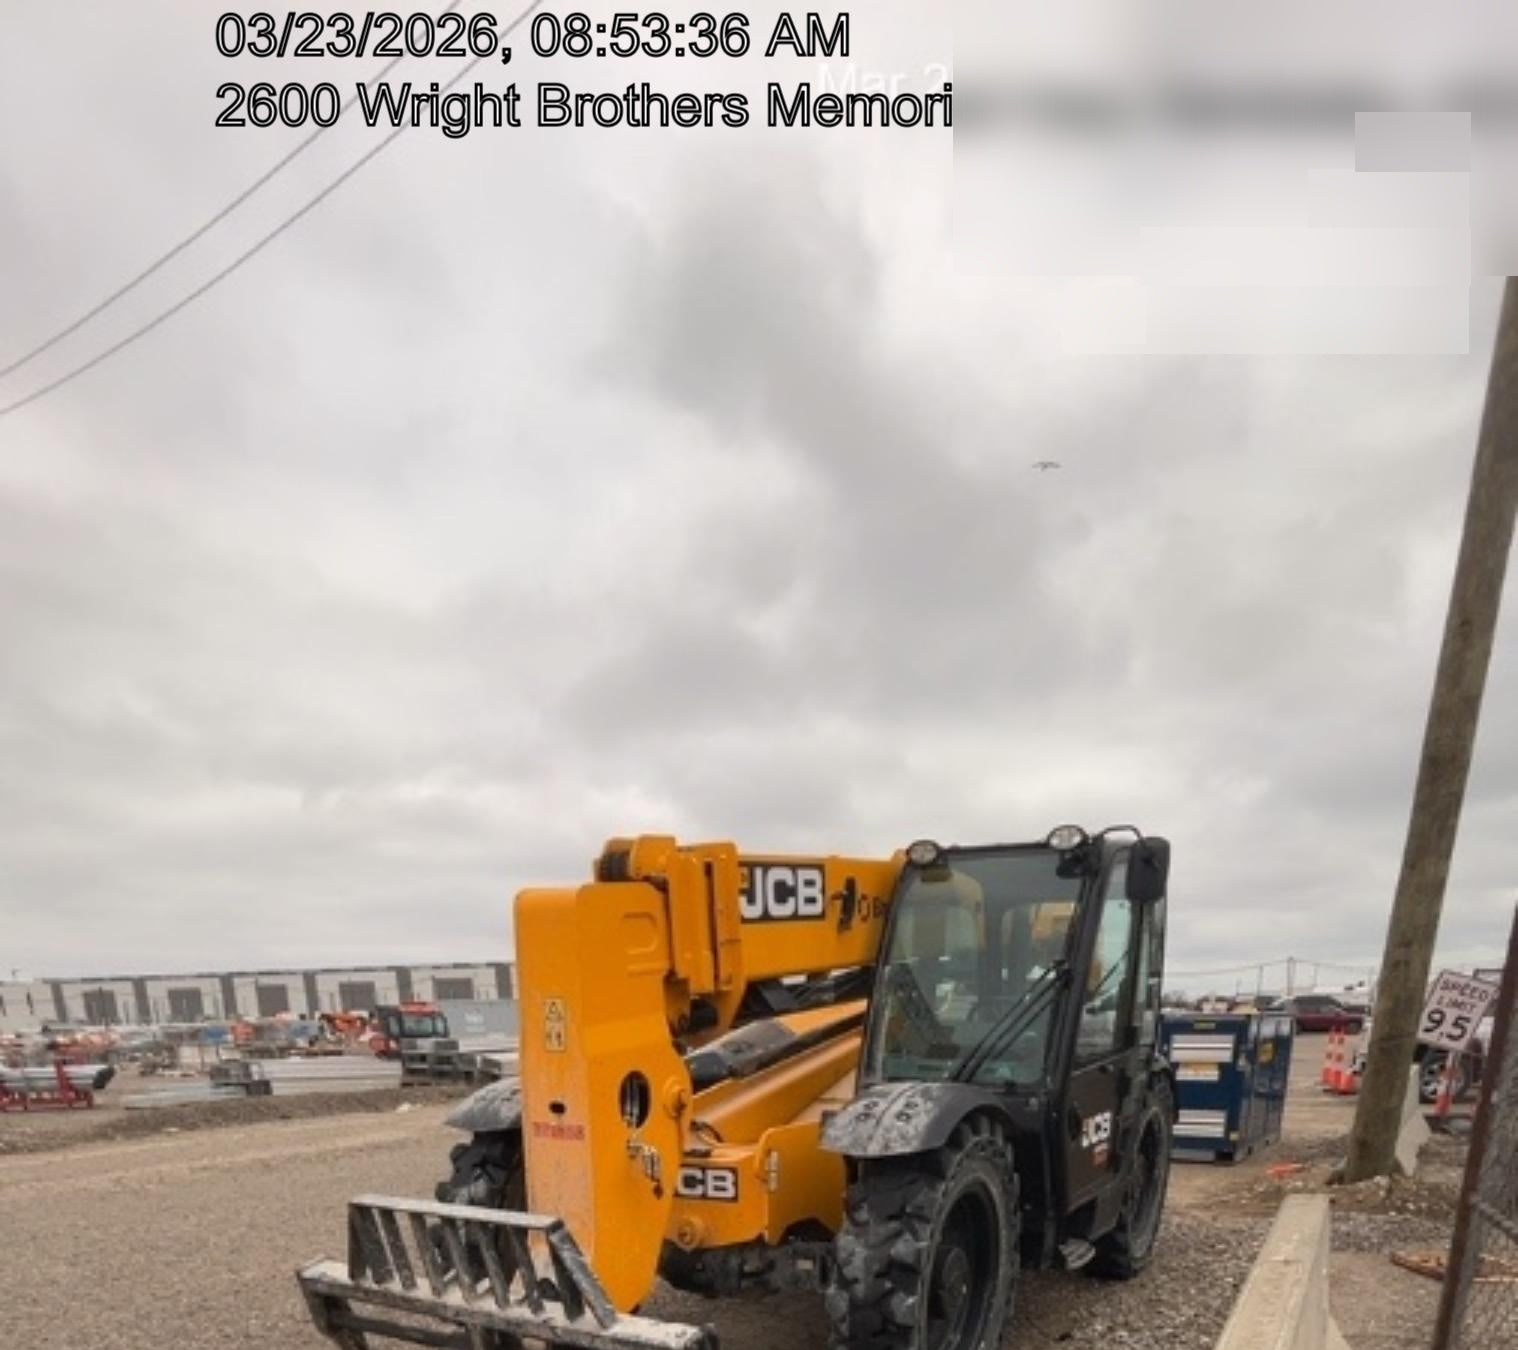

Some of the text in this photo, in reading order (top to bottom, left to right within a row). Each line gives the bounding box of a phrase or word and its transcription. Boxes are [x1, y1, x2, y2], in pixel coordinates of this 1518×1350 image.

[739, 866, 824, 919] JCB
[1440, 979, 1489, 1003] SPEED
[1082, 1112, 1112, 1149] JCB
[679, 1168, 737, 1198] CB
